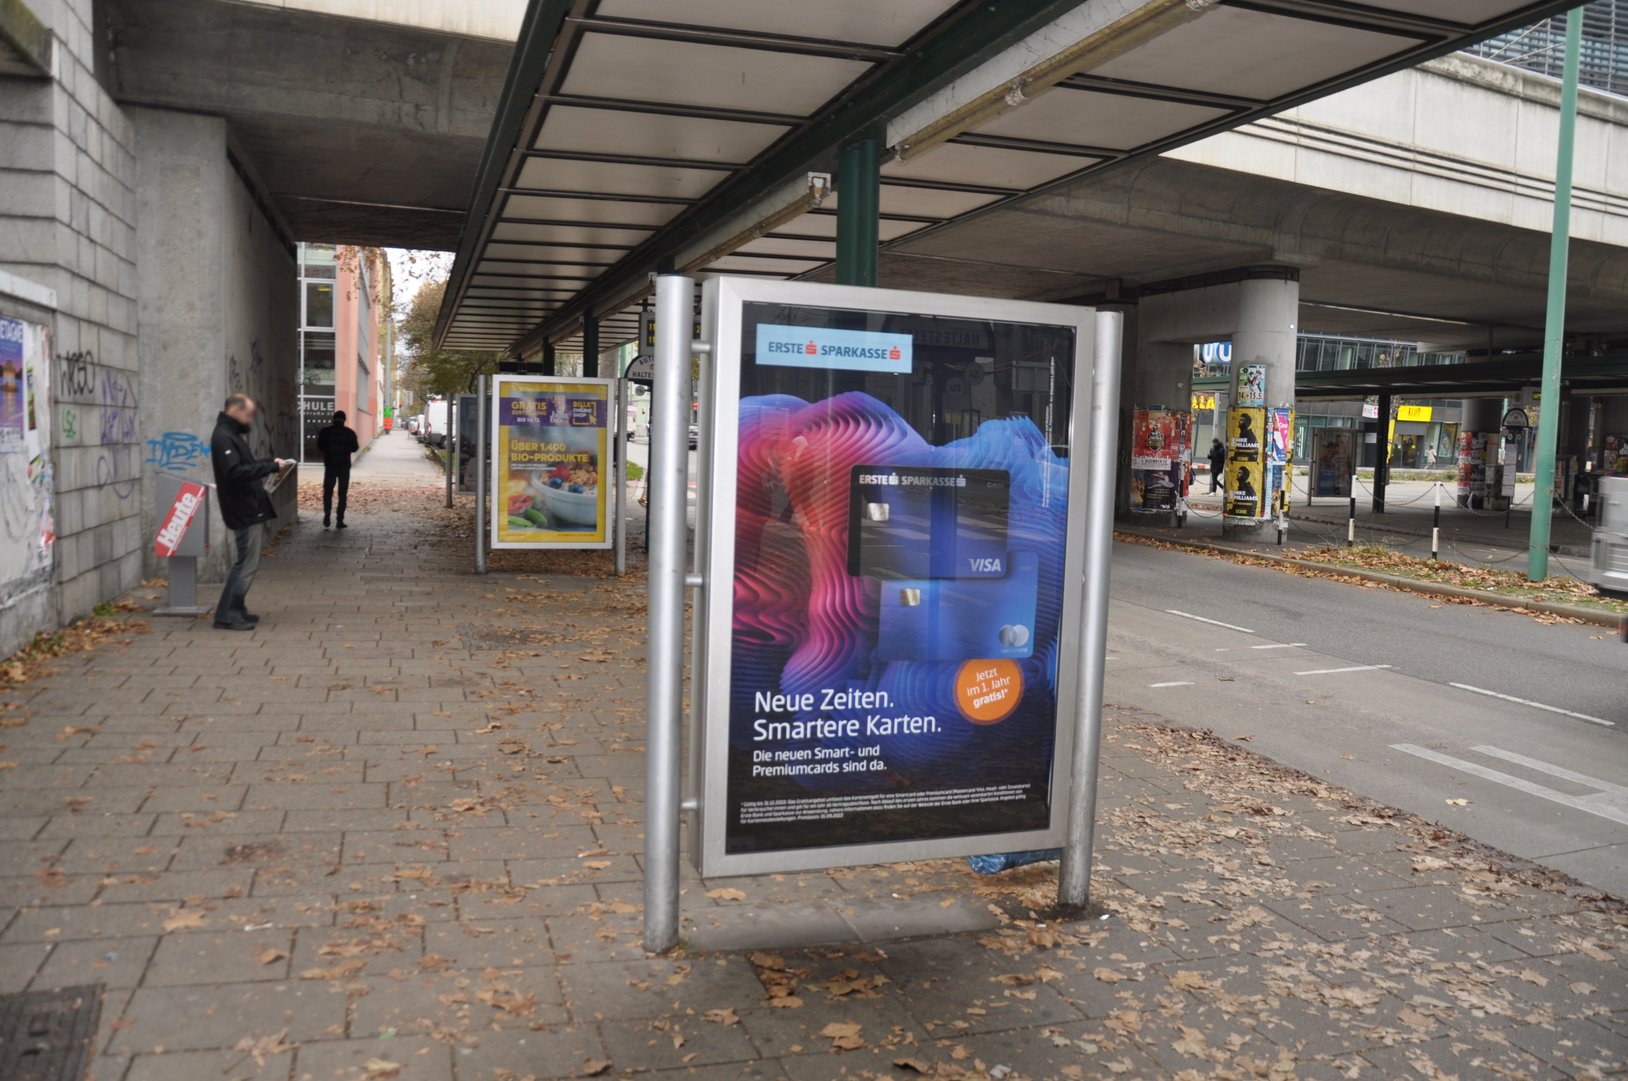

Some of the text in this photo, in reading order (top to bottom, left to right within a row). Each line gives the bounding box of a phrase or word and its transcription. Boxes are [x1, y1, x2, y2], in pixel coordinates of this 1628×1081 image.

[768, 341, 888, 359] ERSTE SPARKASSE
[1219, 343, 1232, 362] U
[511, 440, 566, 452] ÜBER 1.400
[511, 453, 589, 463] BIO-PRODUKTE
[859, 474, 956, 487] ERSTE SPARKASSE
[157, 492, 198, 549] Heute
[968, 558, 1001, 572] VISA
[976, 667, 998, 682] Jetzt
[992, 676, 1011, 689] Jahr
[754, 688, 894, 713] Neue Zeiten.
[753, 714, 942, 741] Smartere Karten.
[753, 745, 880, 762] Die neuen Smart- und
[752, 759, 887, 777] Premiumcards sind da.
